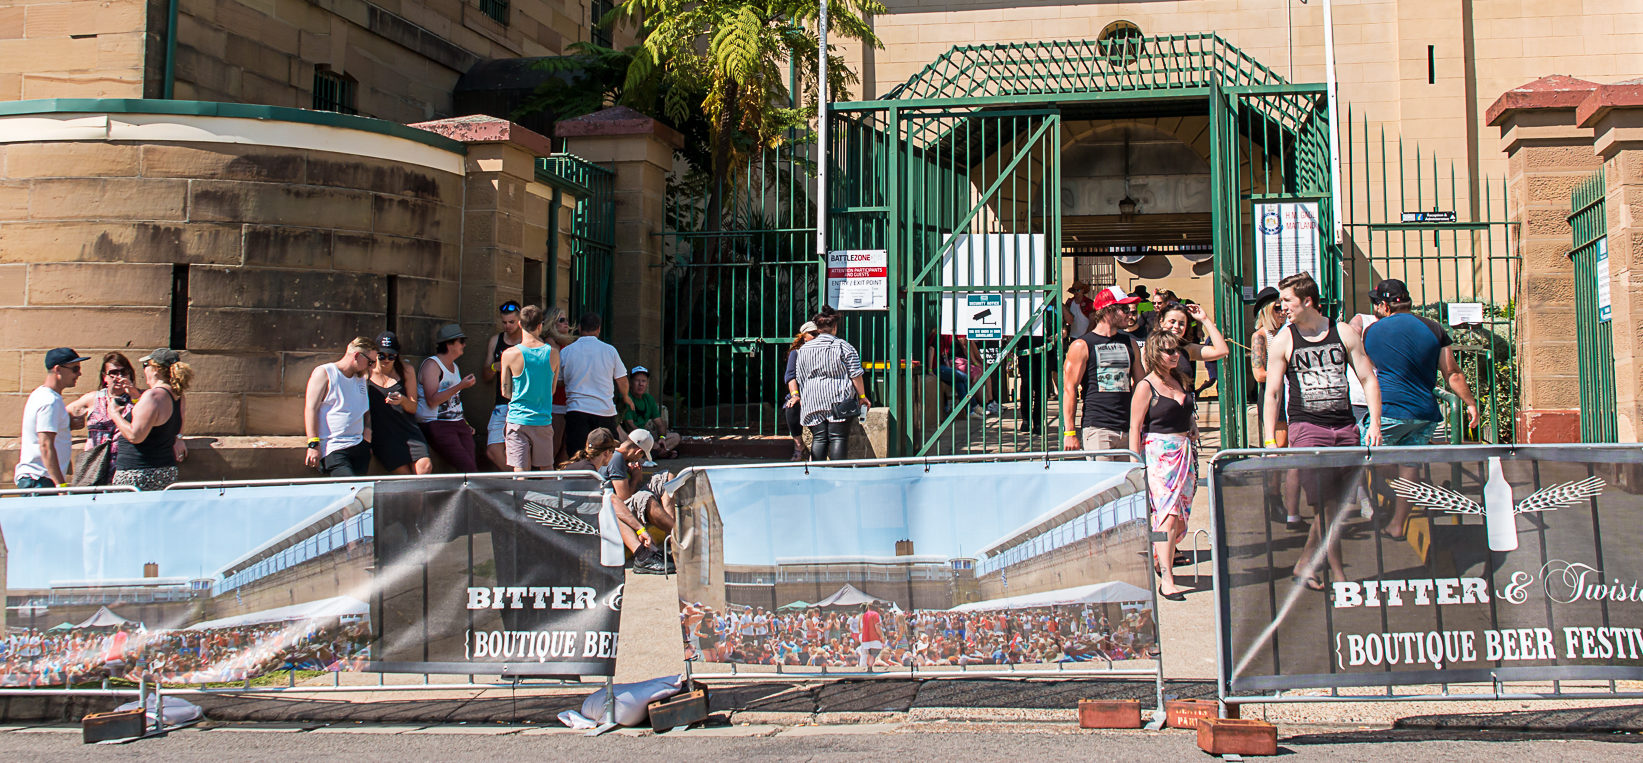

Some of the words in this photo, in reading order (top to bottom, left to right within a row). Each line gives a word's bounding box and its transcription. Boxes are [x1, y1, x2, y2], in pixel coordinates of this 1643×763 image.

[1285, 221, 1318, 230] MAITLAND
[830, 254, 871, 262] BATTLEZONE
[1294, 347, 1344, 371] NYC
[1332, 576, 1491, 608] BITTER
[1495, 570, 1534, 604] &
[1539, 559, 1643, 603] Twist
[466, 586, 598, 610] BITTER
[602, 583, 625, 611] &
[1484, 627, 1557, 661] BEER
